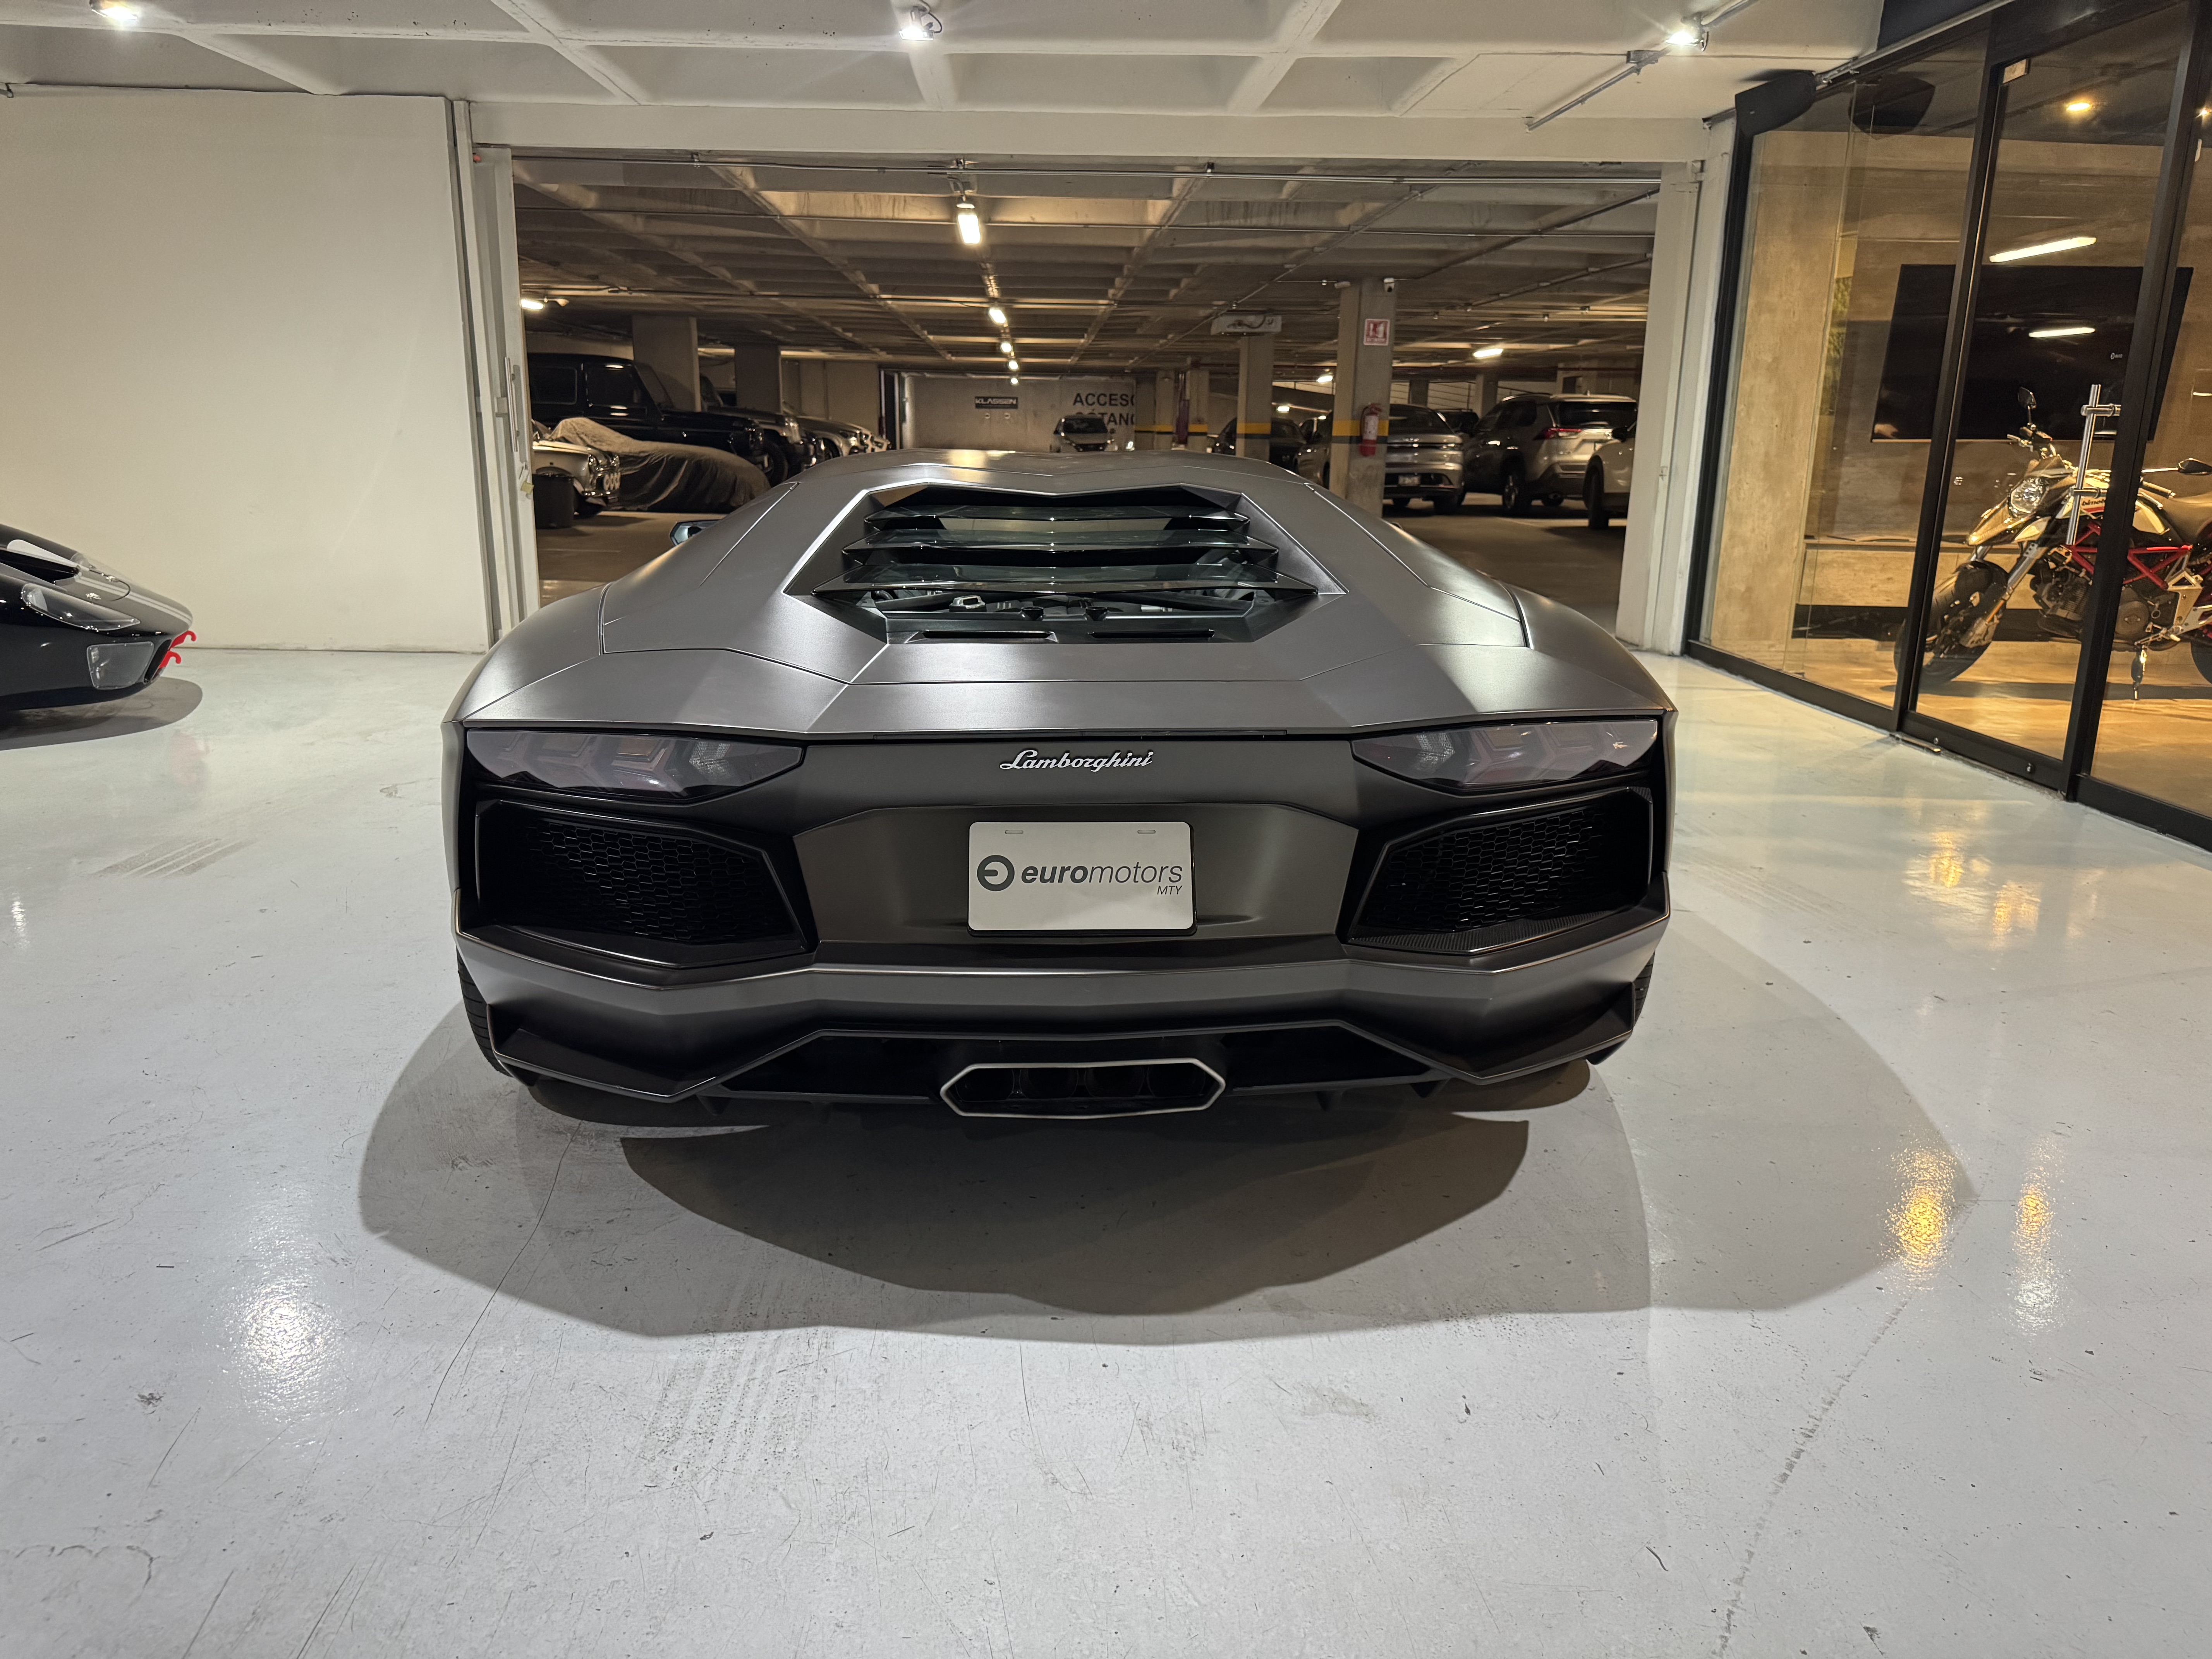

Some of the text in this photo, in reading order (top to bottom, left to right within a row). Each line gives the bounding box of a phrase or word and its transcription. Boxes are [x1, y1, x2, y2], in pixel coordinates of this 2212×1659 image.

[1000, 750, 1154, 772] Lamborghini
[1021, 862, 1183, 883] euromotors
[1157, 886, 1182, 895] MTY
